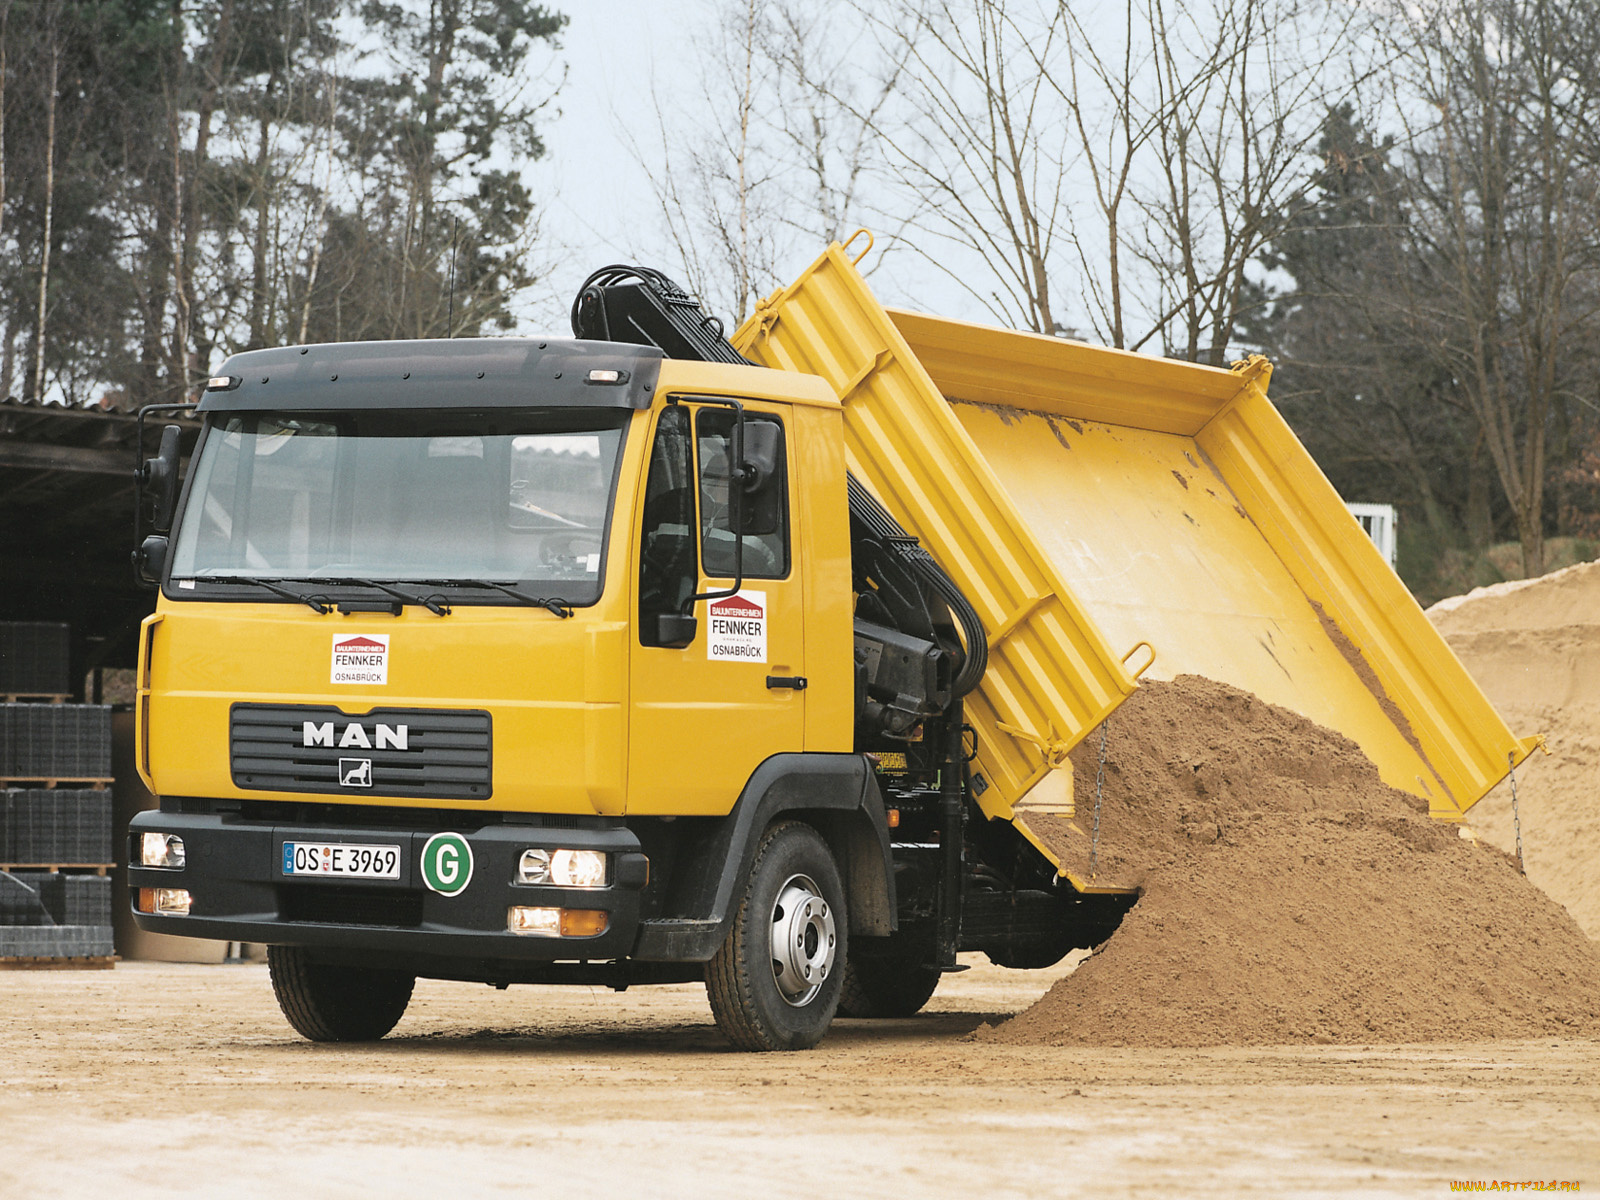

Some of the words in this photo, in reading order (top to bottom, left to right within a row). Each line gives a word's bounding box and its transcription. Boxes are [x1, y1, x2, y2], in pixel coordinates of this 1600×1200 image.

[711, 606, 762, 618] BAUUNTERNEHMEN
[712, 619, 762, 636] FENNKER
[712, 644, 762, 657] OSNABRÜCK
[335, 655, 383, 666] FENNKER
[334, 671, 382, 682] OSNABRÜCK
[303, 721, 408, 750] MAN
[286, 860, 292, 869] D
[296, 847, 319, 871] OS
[332, 849, 343, 872] E
[349, 849, 396, 874] 3969
[436, 843, 459, 885] G
